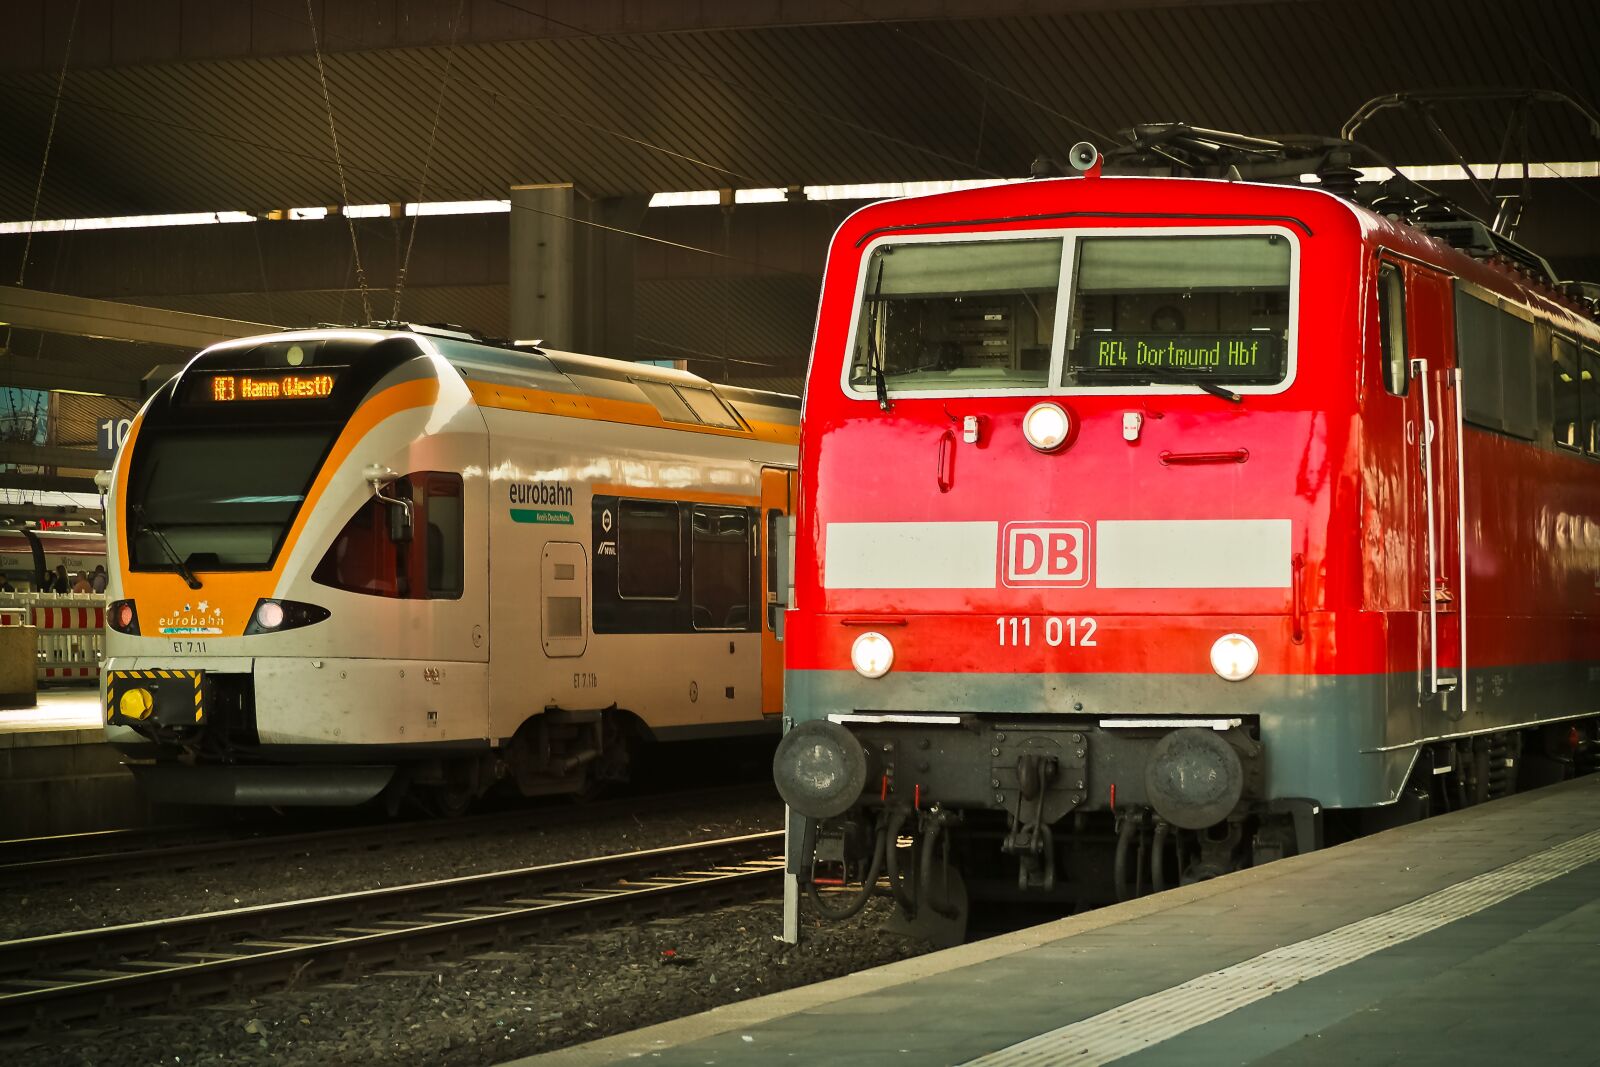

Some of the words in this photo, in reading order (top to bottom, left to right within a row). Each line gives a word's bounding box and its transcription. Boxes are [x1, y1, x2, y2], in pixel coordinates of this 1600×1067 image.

[1099, 341, 1128, 366] RE4
[1137, 341, 1220, 366] Dortmund
[1228, 341, 1258, 366] Hbf
[214, 377, 235, 401] RE3
[242, 378, 279, 397] Hamm
[282, 376, 333, 396] (Westf)
[509, 480, 573, 506] eurobahn
[1014, 533, 1078, 575] DB
[159, 615, 224, 626] eurobahn
[996, 617, 1030, 647] 111
[1045, 617, 1097, 647] 012
[173, 641, 183, 653] ET
